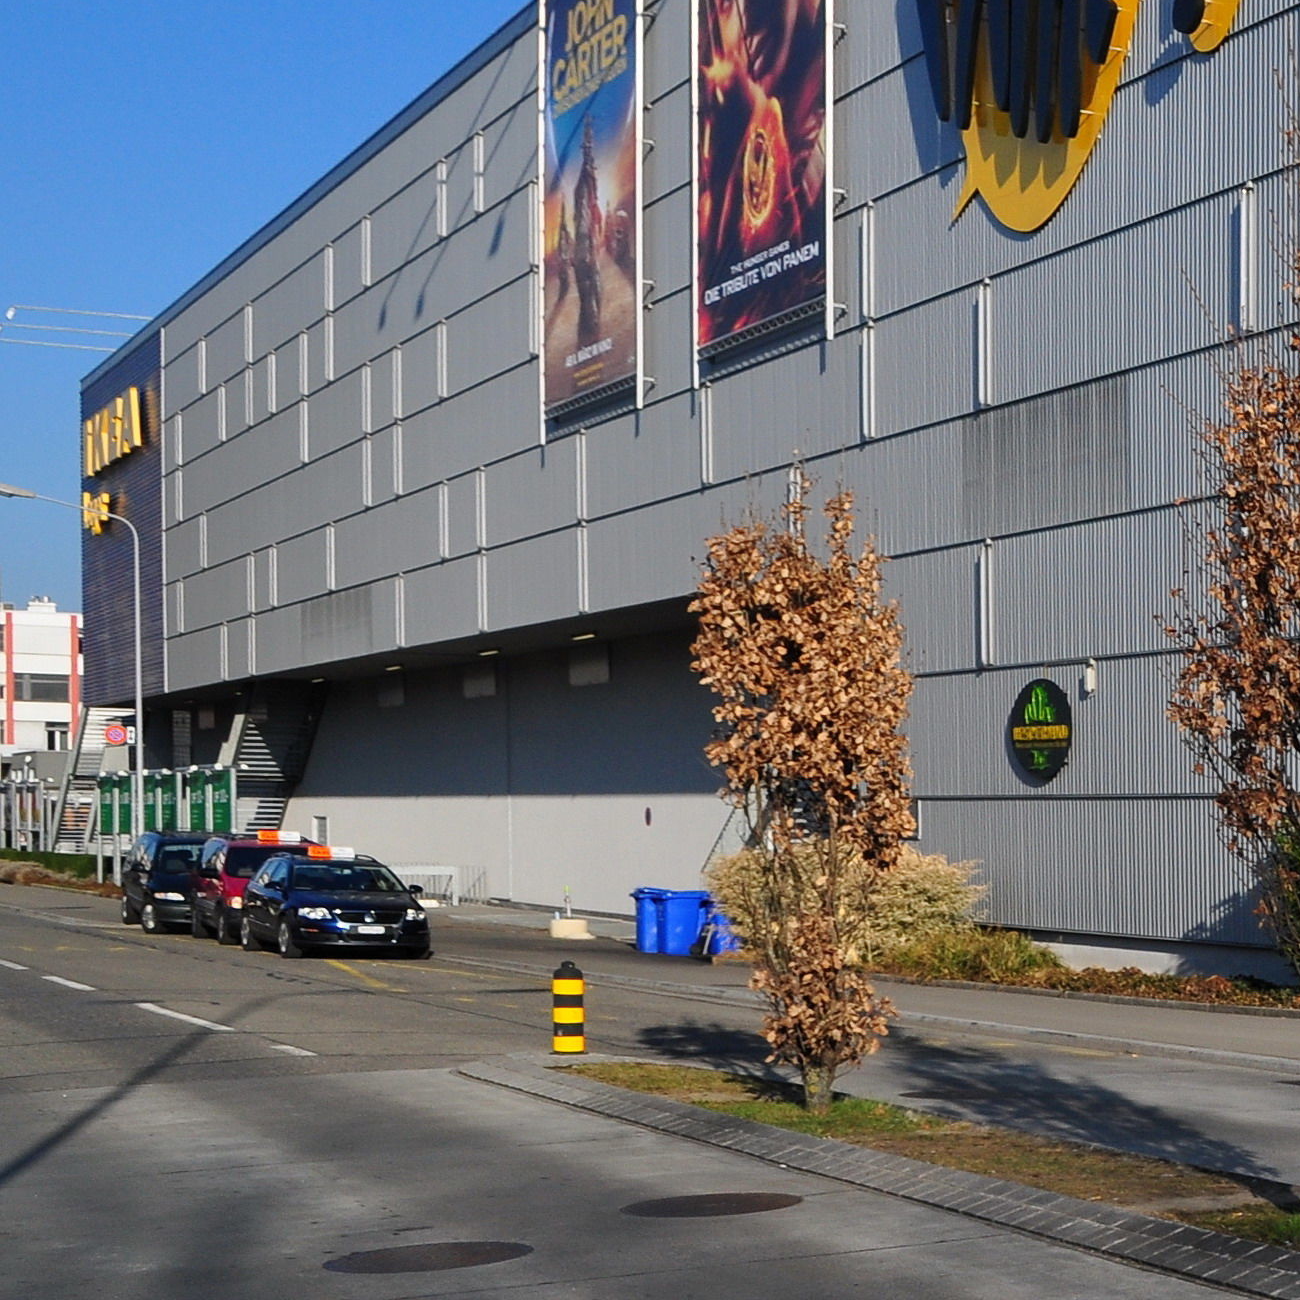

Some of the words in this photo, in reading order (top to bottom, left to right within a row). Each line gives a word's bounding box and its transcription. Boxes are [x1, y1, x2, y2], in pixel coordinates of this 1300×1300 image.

[552, 13, 628, 102] CARTER
[704, 285, 721, 305] DIE
[721, 268, 760, 298] TRIBUTE
[760, 258, 782, 280] VON
[783, 240, 820, 271] PANEM
